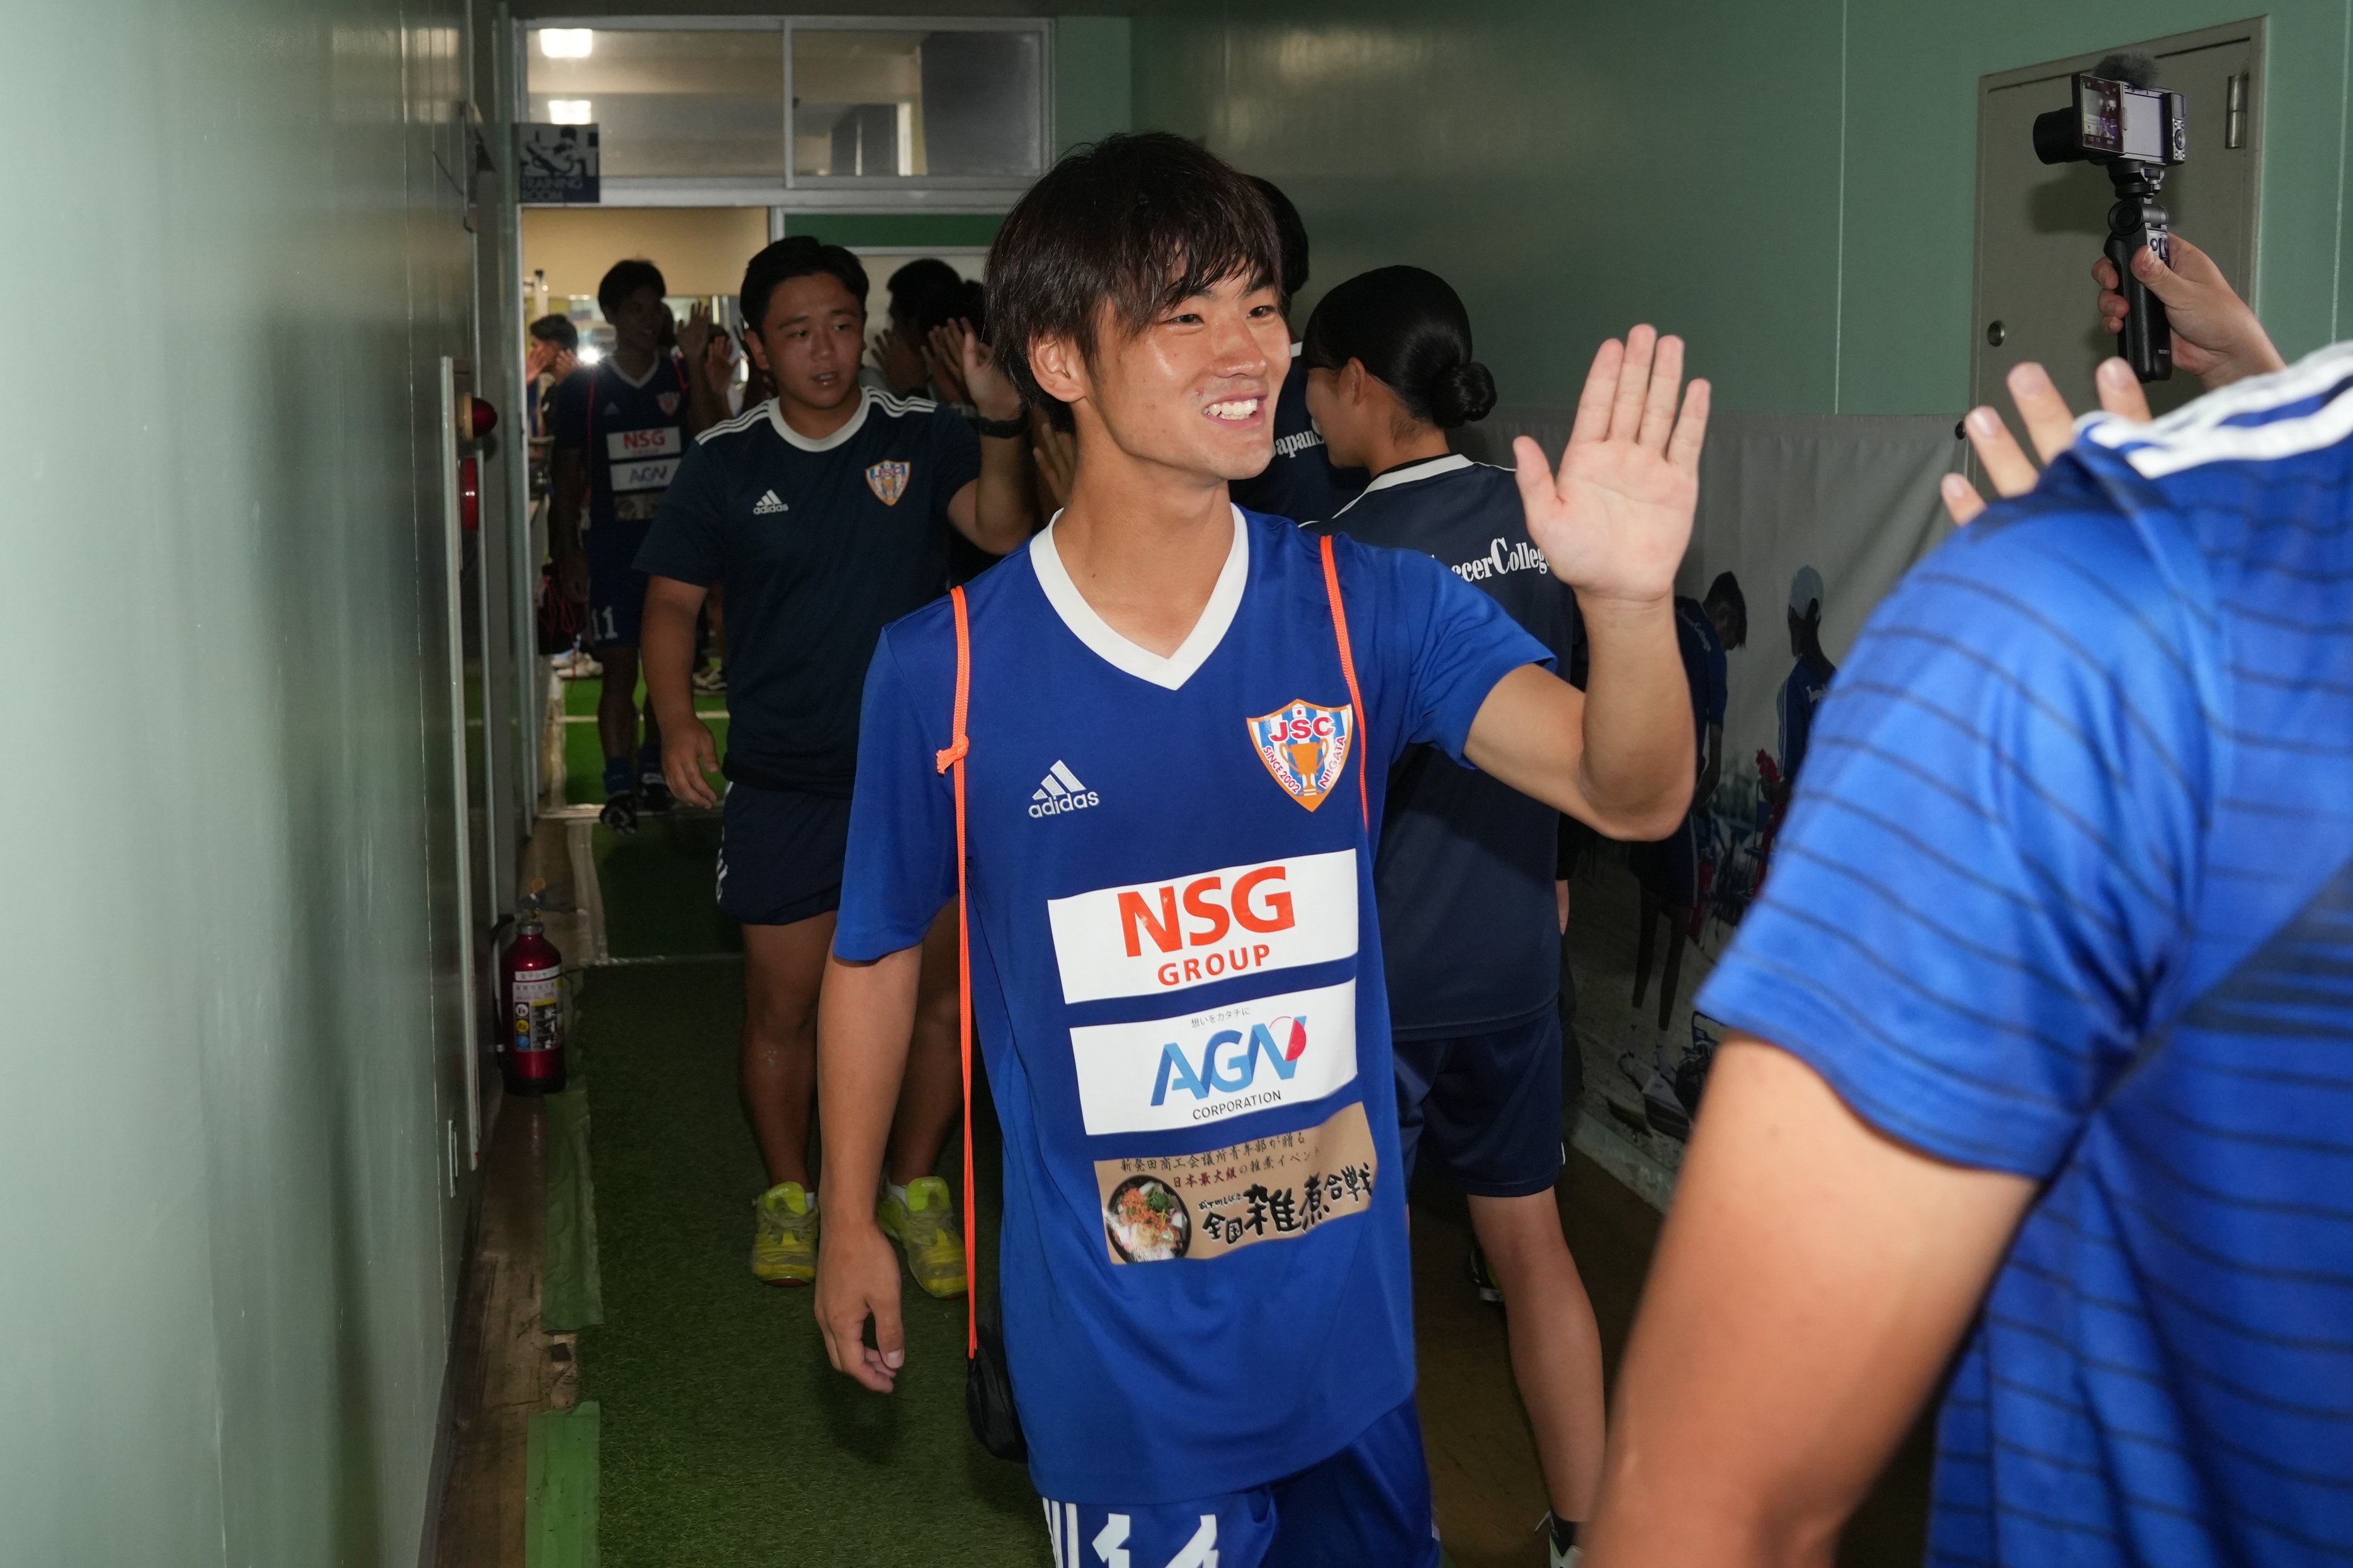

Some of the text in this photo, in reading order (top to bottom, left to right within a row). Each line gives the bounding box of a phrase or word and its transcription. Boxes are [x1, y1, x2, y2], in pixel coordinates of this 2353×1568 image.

[623, 429, 666, 449] NSG
[875, 466, 900, 477] JSC
[752, 503, 789, 516] adidas
[591, 606, 618, 641] 11
[1269, 716, 1335, 742] JSC
[1262, 745, 1283, 772] SINCE
[1318, 736, 1346, 789] NIIGATA
[1279, 770, 1301, 793] 2002
[1028, 791, 1100, 818] adidas
[1117, 866, 1296, 957] NSG
[1157, 944, 1270, 986] GROUP
[1190, 1007, 1250, 1028] 想いをカタチに
[1150, 1015, 1308, 1107] AGN
[1192, 1089, 1282, 1121] CORPORATION
[1120, 1132, 1305, 1173] 新発田商工会議所青年部が贈る
